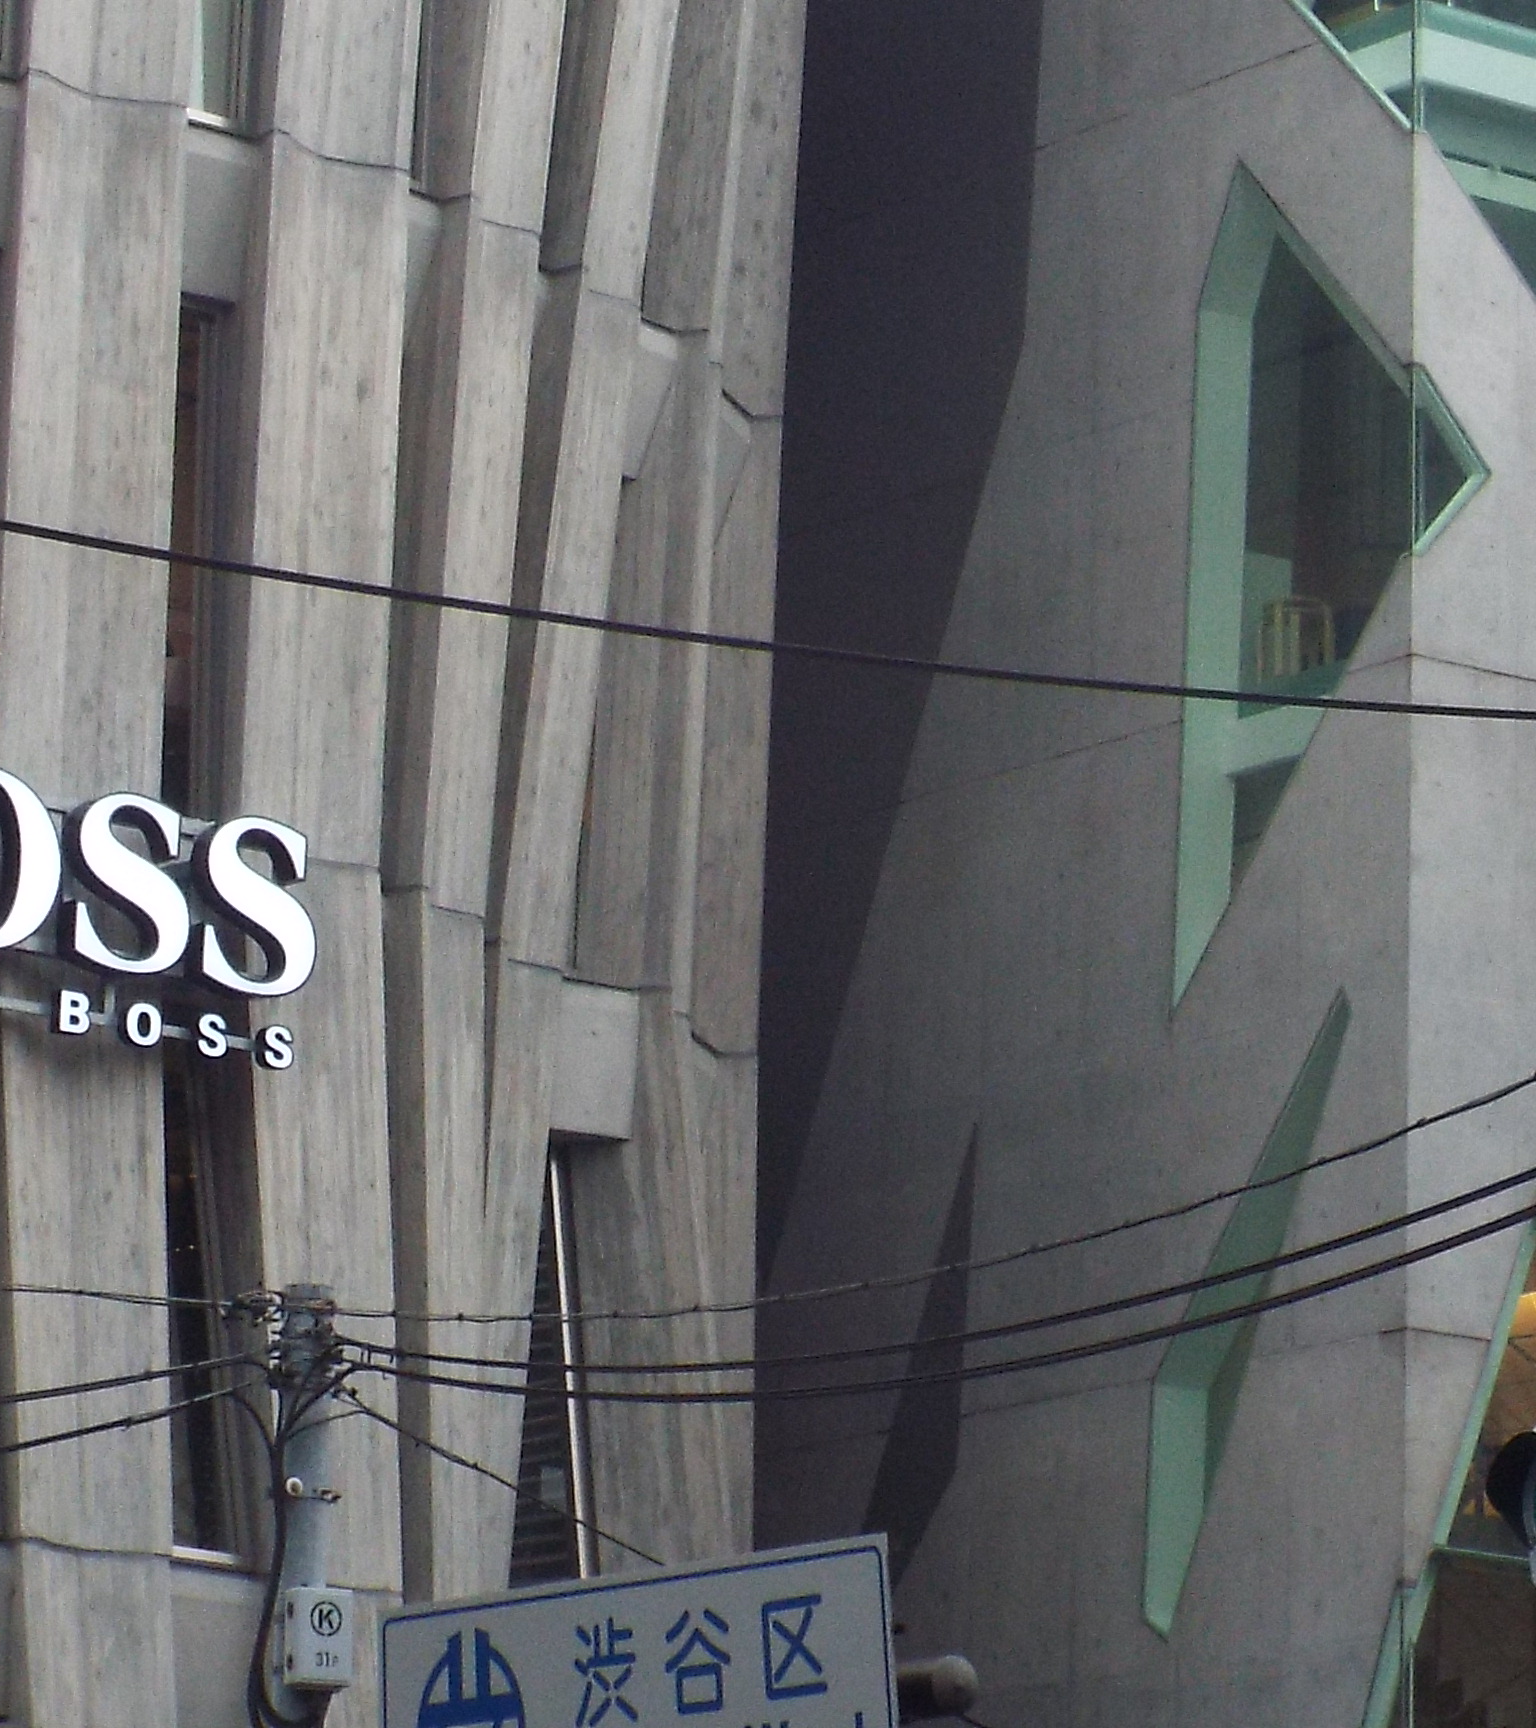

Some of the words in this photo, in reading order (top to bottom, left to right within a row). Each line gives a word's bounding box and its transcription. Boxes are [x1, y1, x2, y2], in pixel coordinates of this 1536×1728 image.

[54, 988, 294, 1069] BOSS
[574, 1593, 828, 1727] 渋谷区
